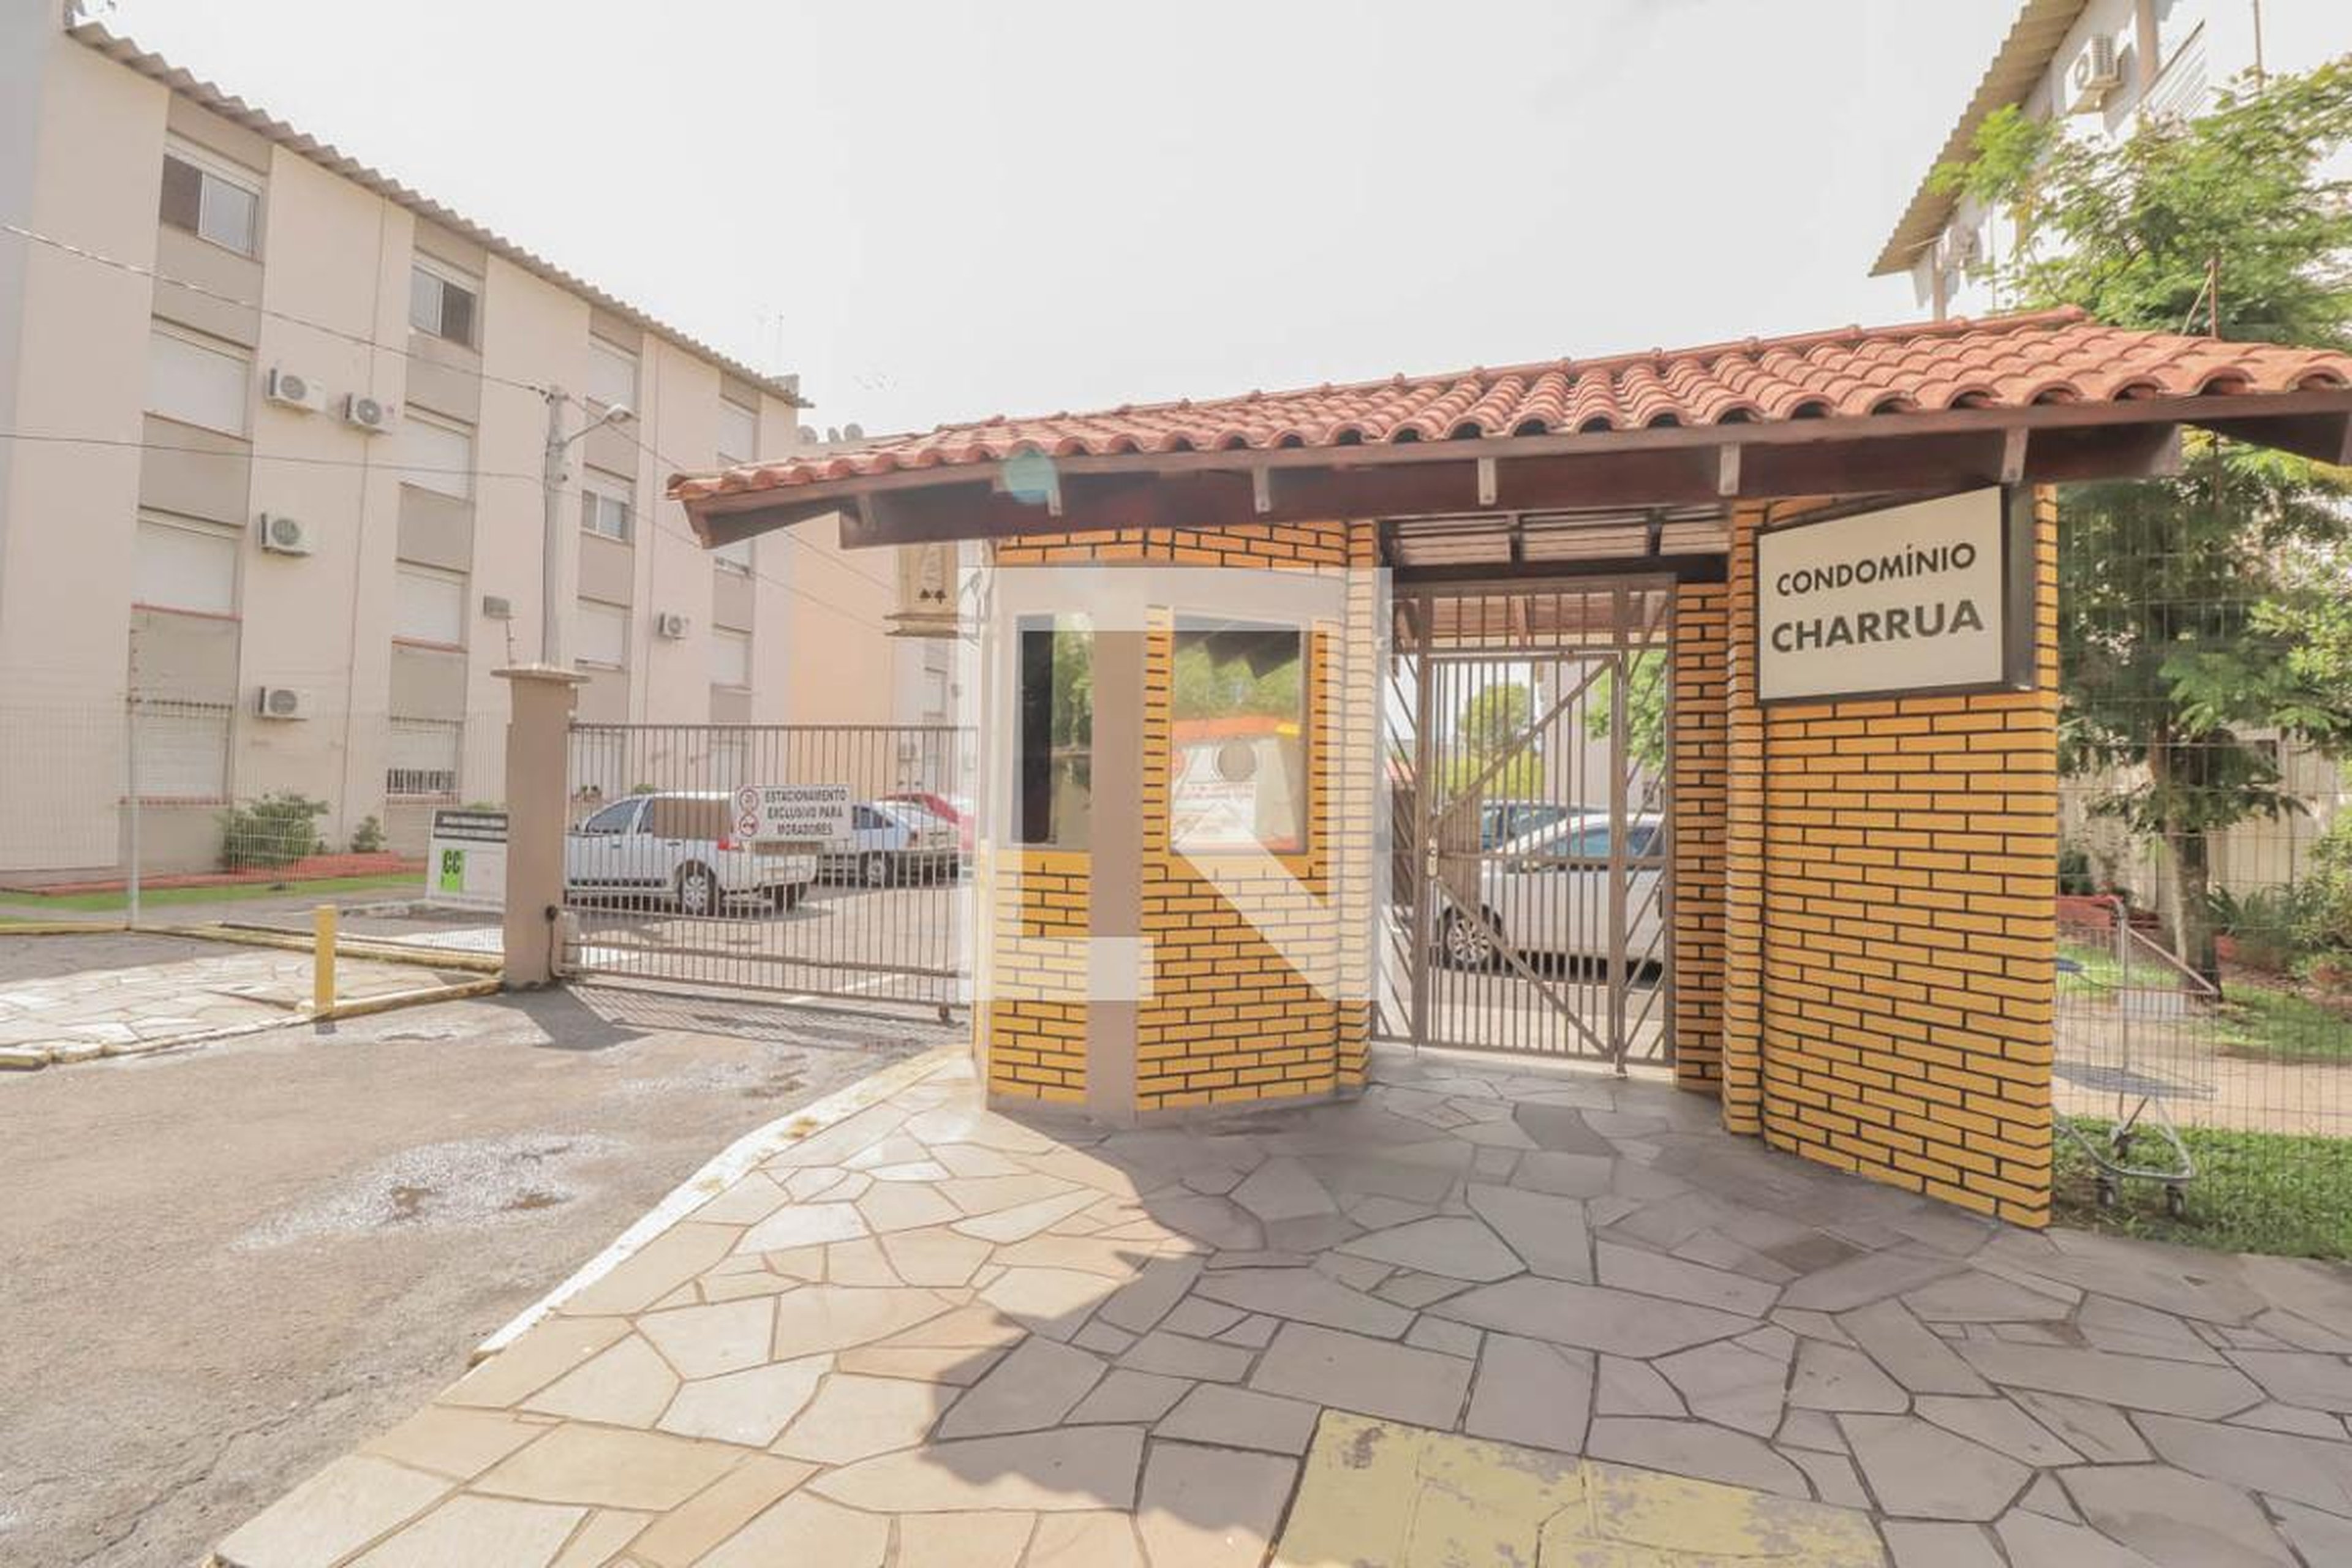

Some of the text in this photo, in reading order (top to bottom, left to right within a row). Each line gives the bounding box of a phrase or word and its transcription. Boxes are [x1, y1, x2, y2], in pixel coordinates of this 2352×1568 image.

[1776, 543, 1977, 597] CONDOMÍNIO
[1771, 599, 1984, 653] CHARRUA
[765, 789, 847, 803] ESTACIONAMENTO
[767, 805, 843, 820] EXCLUSIVO PARA
[777, 822, 834, 836] MORADORES
